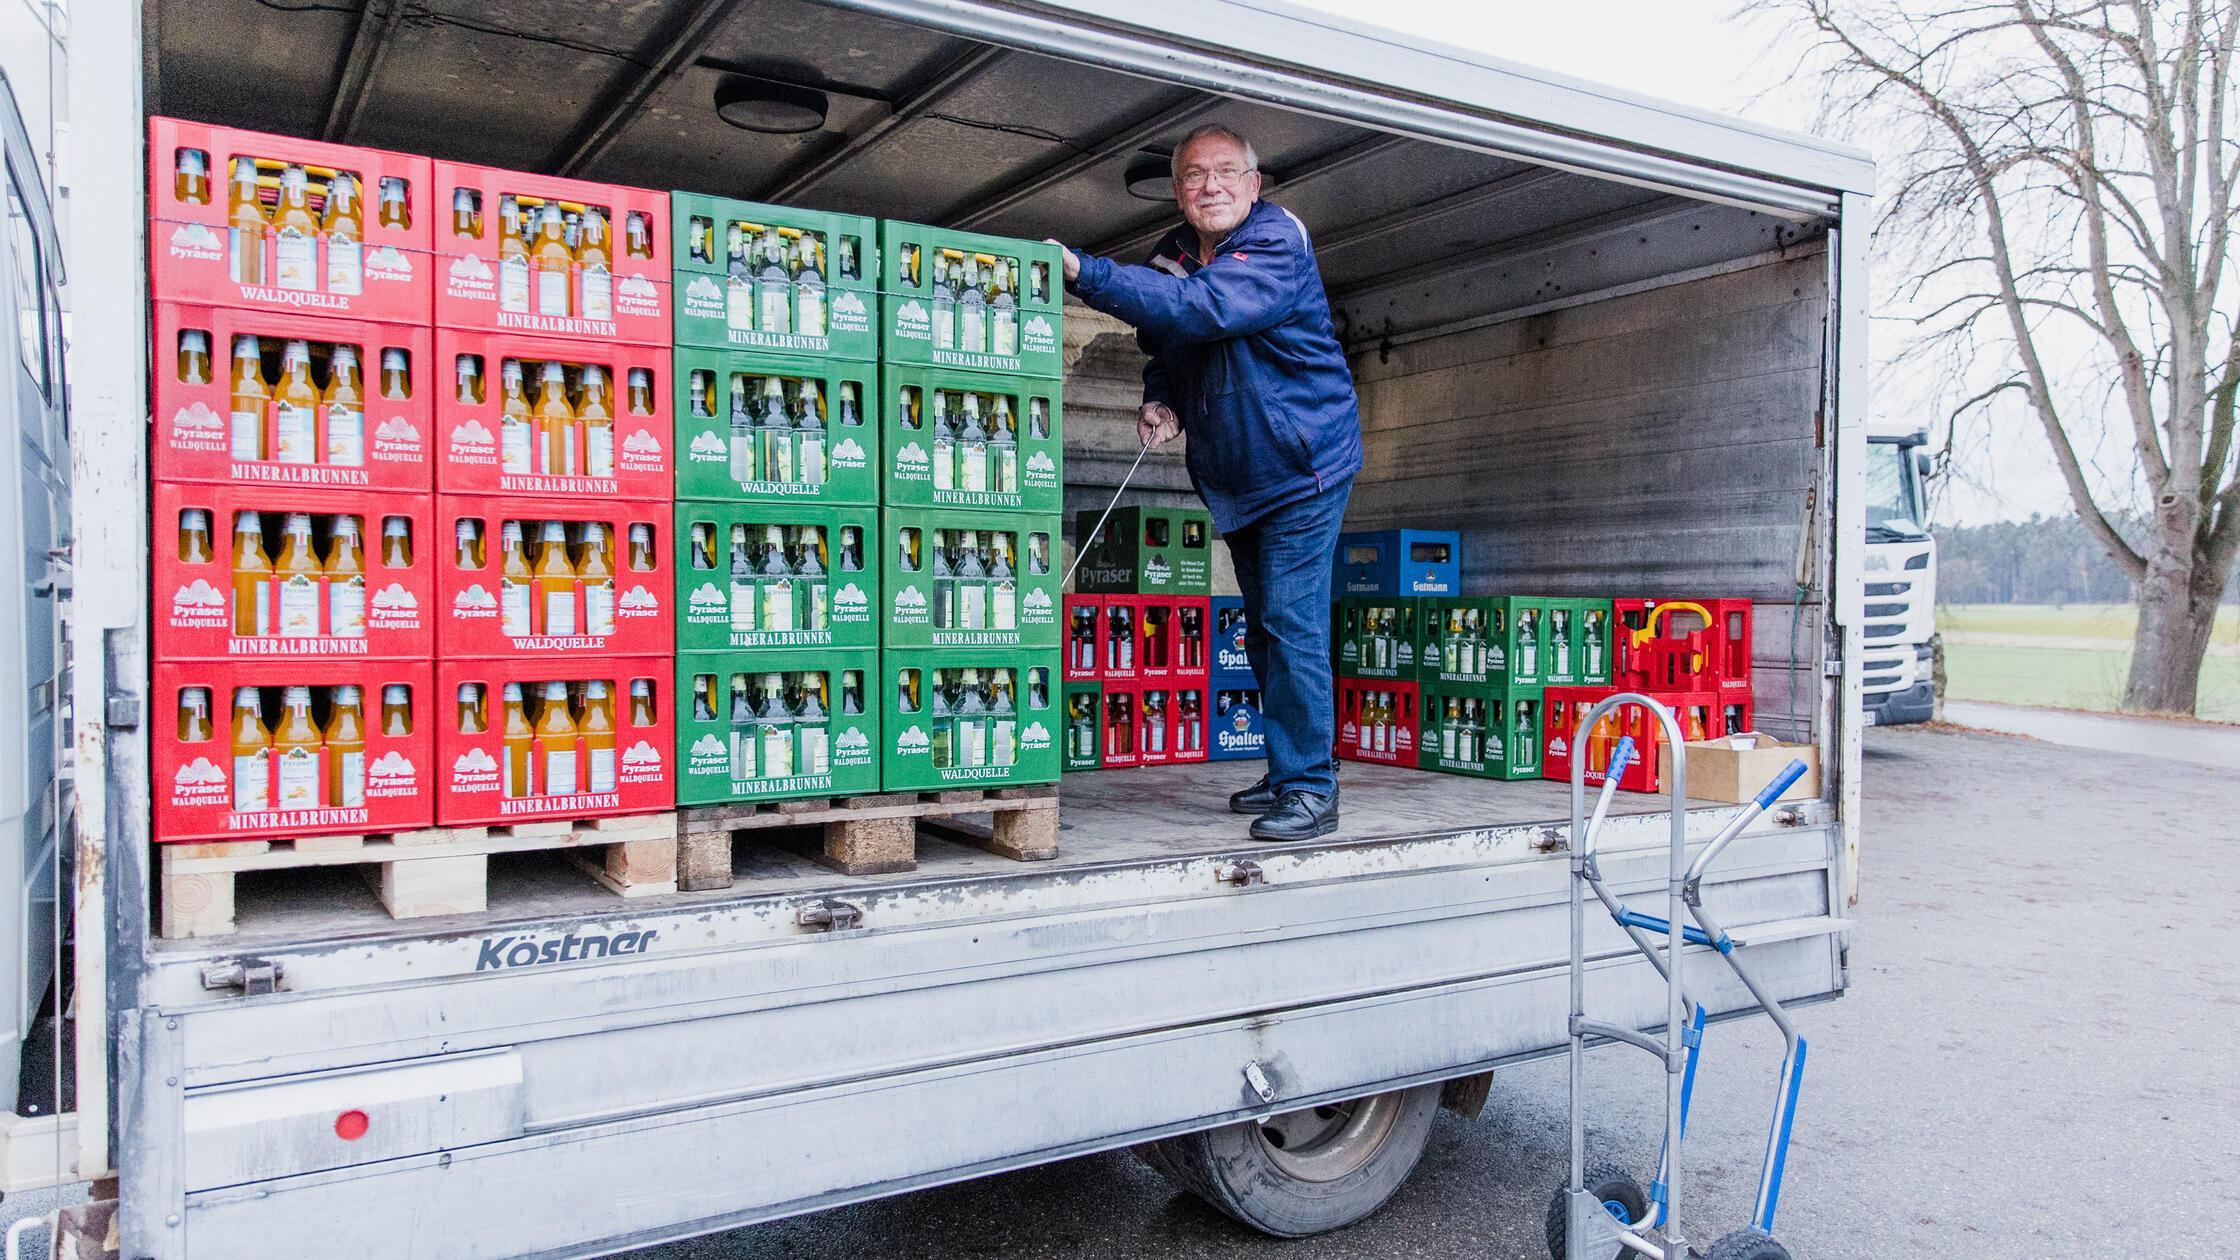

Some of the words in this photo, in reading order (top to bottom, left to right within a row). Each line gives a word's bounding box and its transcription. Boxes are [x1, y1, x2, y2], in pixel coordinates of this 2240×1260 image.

[170, 247, 223, 261] Pyraser
[365, 269, 413, 282] Pyraser
[450, 278, 494, 290] Pyraser
[240, 287, 349, 309] WALDQUELLE
[447, 289, 496, 301] WALDQUELLE
[619, 295, 659, 308] Pyraser
[687, 297, 724, 309] Pyraser
[616, 306, 661, 317] WALDQUELLE
[684, 308, 725, 319] WALDQUELLE
[833, 312, 867, 323] Pyraser
[497, 312, 616, 336] MINERALBRUNNEN
[832, 322, 869, 332] WALDQUELLE
[897, 320, 930, 331] Pyraser
[728, 330, 829, 350] MINERALBRUNNEN
[896, 329, 931, 341] WALDQUELLE
[1024, 335, 1054, 345] Pyraser
[1023, 344, 1055, 354] WALDQUELLE
[933, 351, 1020, 370] MINERALBRUNNEN
[173, 428, 224, 440] Pyraser
[170, 440, 227, 451] WALDQUELLE
[374, 440, 421, 452] Pyraser
[451, 444, 495, 455] Pyraser
[372, 451, 423, 462] WALDQUELLE
[448, 455, 497, 465] WALDQUELLE
[623, 452, 662, 463] Pyraser
[690, 452, 727, 462] Pyraser
[620, 463, 664, 472] WALDQUELLE
[832, 459, 866, 468] Pyraser
[897, 463, 929, 472] Pyraser
[231, 464, 369, 485] MINERALBRUNNEN
[895, 472, 931, 481] WALDQUELLE
[1026, 471, 1056, 480] Pyraser
[501, 477, 617, 493] MINERALBRUNNEN
[741, 483, 820, 496] WALDQUELLE
[1024, 480, 1057, 489] WALDQUELLE
[933, 491, 1022, 506] MINERALBRUNNEN
[1081, 566, 1132, 587] Pyraser
[1144, 570, 1172, 579] Pyraser
[1347, 582, 1379, 592] Gutmann
[1413, 581, 1448, 592] Gutmann
[174, 606, 224, 617] Pyraser
[372, 608, 418, 619] Pyraser
[453, 609, 497, 619] Pyraser
[619, 609, 659, 618] Pyraser
[689, 605, 727, 614] Pyraser
[834, 605, 867, 613] Pyraser
[896, 607, 927, 615] Pyraser
[1023, 608, 1053, 616] Pyraser
[170, 618, 228, 628] WALDQUELLE
[688, 616, 729, 624] WALDQUELLE
[832, 614, 869, 622] WALDQUELLE
[893, 616, 929, 624] WALDQUELLE
[1022, 616, 1054, 624] WALDQUELLE
[368, 620, 420, 629] WALDQUELLE
[512, 637, 605, 650] WALDQUELLE
[730, 631, 832, 646] MINERALBRUNNEN
[933, 633, 1020, 645] MINERALBRUNNEN
[229, 639, 368, 654] MINERALBRUNNEN
[1219, 649, 1251, 667] Spal
[1070, 670, 1095, 678] Pyraser
[1584, 676, 1604, 684] Pyraser
[1219, 731, 1264, 748] Spalter
[897, 746, 930, 755] Pyraser
[1021, 742, 1050, 750] Pyraser
[836, 748, 870, 757] Pyraser
[691, 756, 728, 765] Pyraser
[834, 757, 871, 766] WALDQUELLE
[1070, 759, 1095, 767] Pyraser
[622, 764, 662, 775] Pyraser
[689, 766, 729, 775] WALDQUELLE
[941, 768, 1010, 780] WALDQUELLE
[369, 776, 415, 788] Pyraser
[454, 773, 498, 784] Pyraser
[620, 774, 663, 784] WALDQUELLE
[175, 784, 227, 795] Pyraser
[451, 783, 500, 792] WALDQUELLE
[732, 776, 832, 795] MINERALBRUNNEN
[366, 787, 418, 797] WALDQUELLE
[171, 795, 229, 806] WALDQUELLE
[501, 795, 619, 814] MINERALBRUNNEN
[229, 809, 368, 829] MINERALBRUNNEN
[476, 930, 657, 971] Köstner
